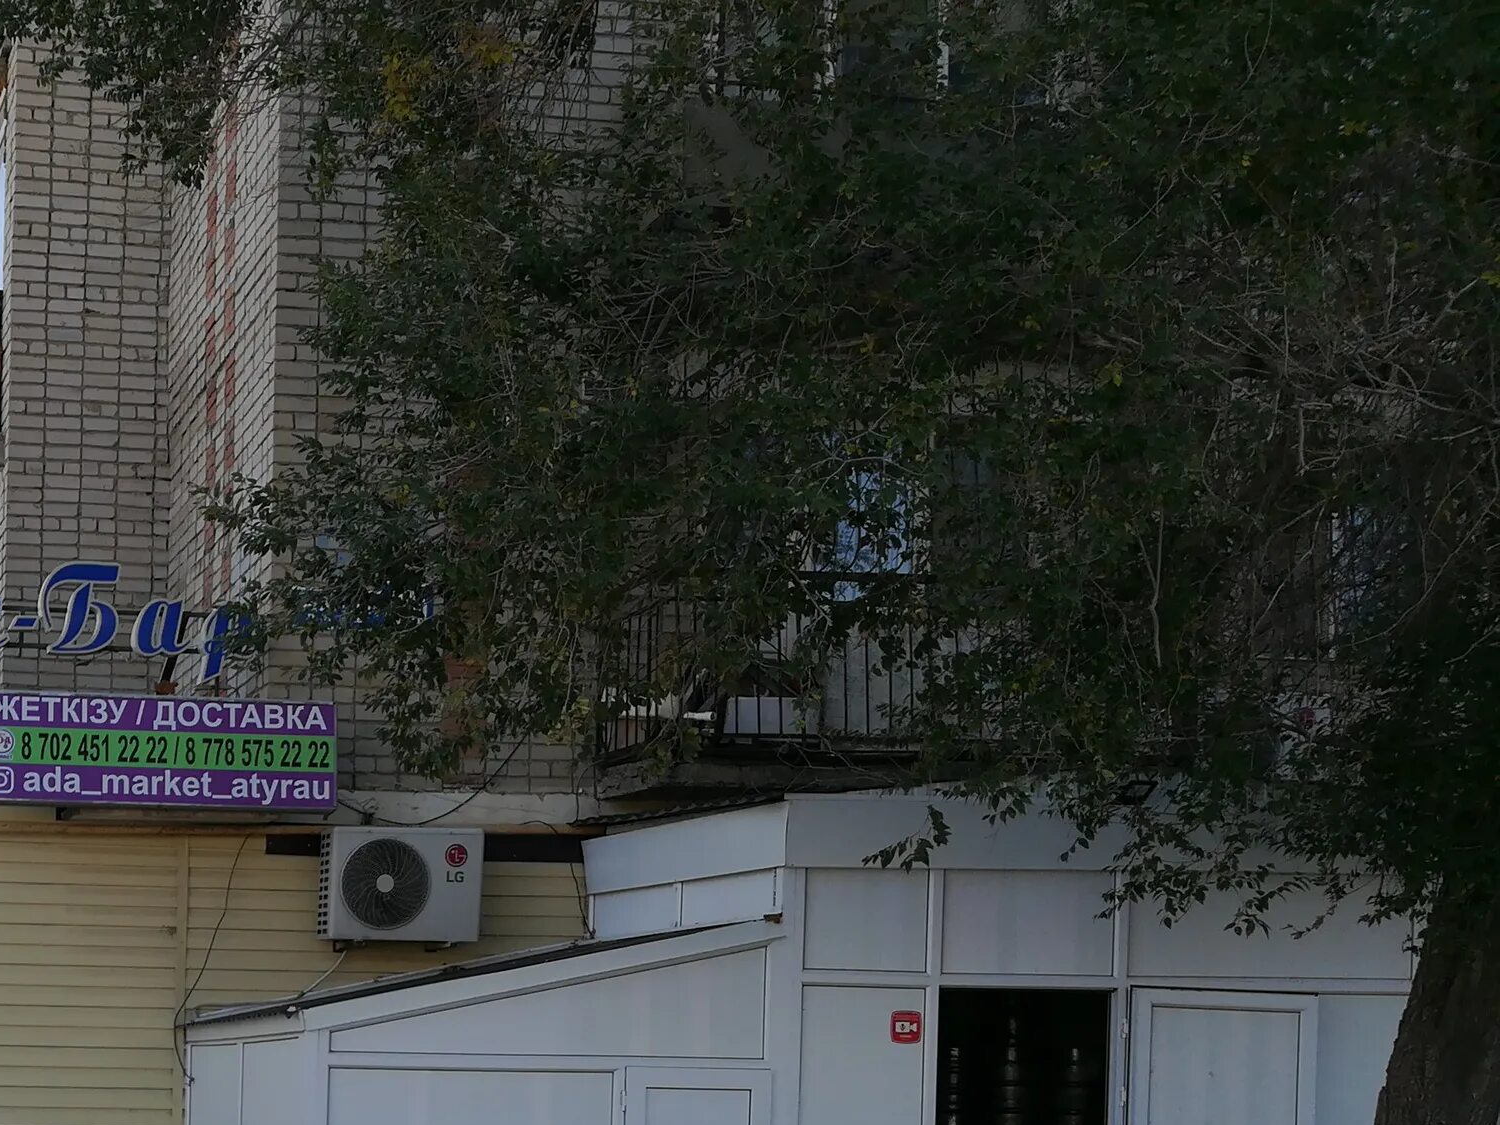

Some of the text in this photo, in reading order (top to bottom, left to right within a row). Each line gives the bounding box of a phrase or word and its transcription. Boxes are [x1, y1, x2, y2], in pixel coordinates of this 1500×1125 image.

[136, 700, 145, 726] /
[153, 701, 327, 731] ДОСТАВКА
[21, 732, 329, 768] 8 702 451 22 22 / 8 778 575 22 22
[23, 766, 330, 805] ada_market_atyrau
[446, 871, 465, 883] LG
